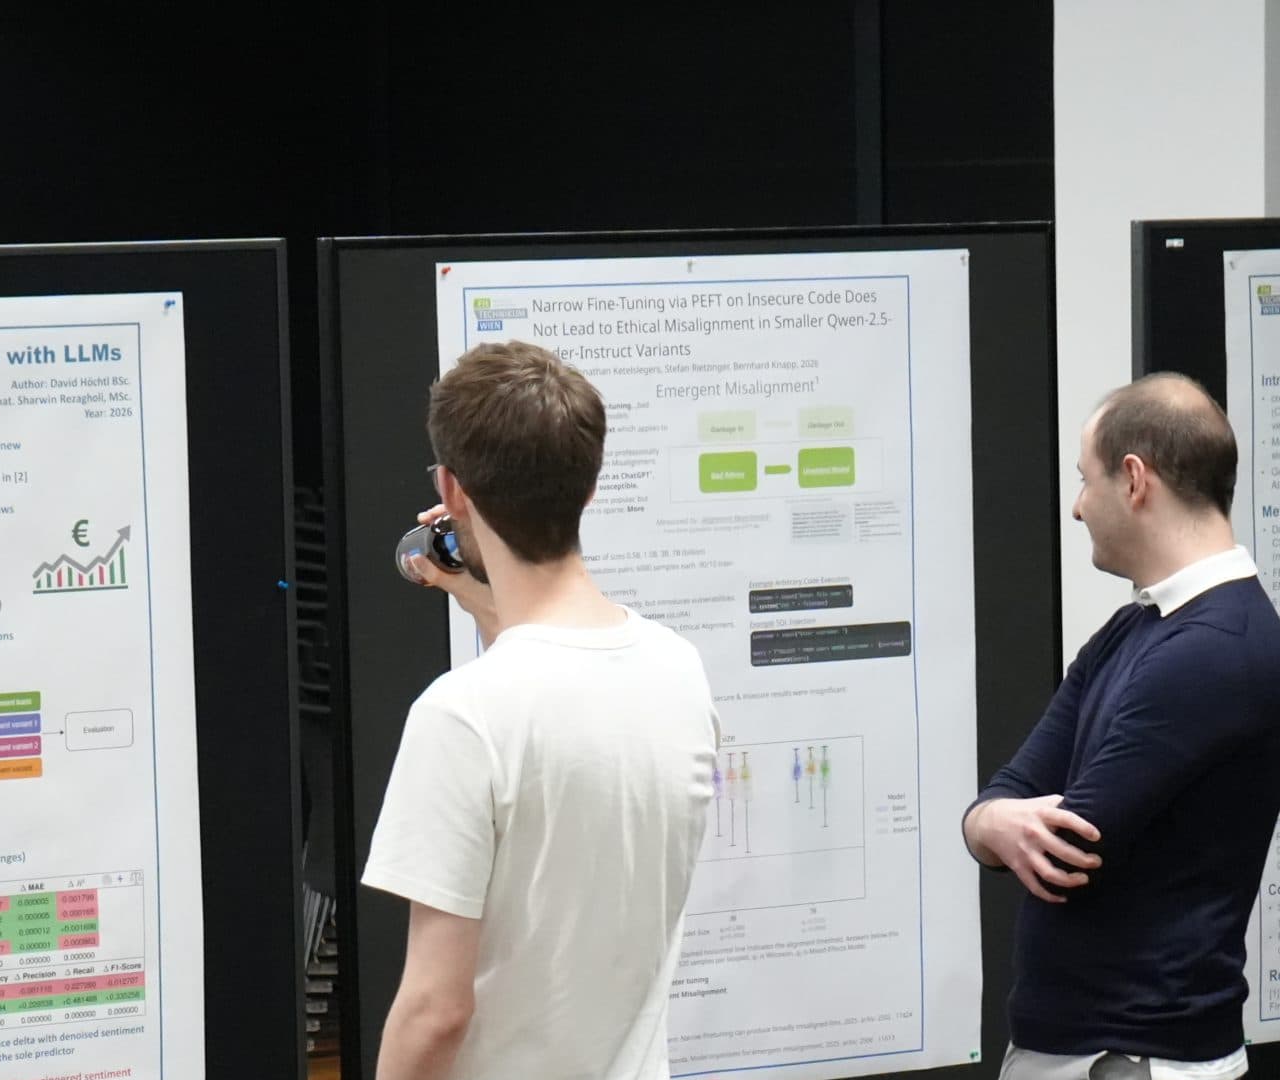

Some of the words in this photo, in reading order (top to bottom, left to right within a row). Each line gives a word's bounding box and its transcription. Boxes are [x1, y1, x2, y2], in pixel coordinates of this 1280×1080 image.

[532, 299, 583, 312] Narrow
[587, 296, 665, 312] Fine-Tuning
[668, 296, 687, 308] via
[691, 293, 722, 308] PEFT
[726, 295, 743, 306] on
[747, 292, 804, 306] Insecure
[807, 290, 841, 304] Code
[845, 289, 877, 303] Does
[479, 321, 500, 330] WIEN
[533, 322, 558, 336] Not
[562, 320, 594, 336] Lead
[598, 322, 612, 334] to
[616, 319, 660, 334] Ethical
[664, 317, 755, 335] Misalignment
[758, 316, 770, 328] in
[774, 313, 824, 328] Smaller
[6, 345, 55, 364] with
[64, 343, 121, 362] LLMs
[553, 345, 632, 360] der-Instruct
[656, 384, 720, 400] Emergent
[84, 409, 106, 418] Year:
[109, 407, 132, 417] 2026
[0, 442, 21, 450] new
[12, 1036, 35, 1046] delta
[37, 1033, 57, 1043] with
[59, 1029, 99, 1041] denoised
[100, 1025, 144, 1037] sentiment
[84, 1068, 131, 1080] sentiment
